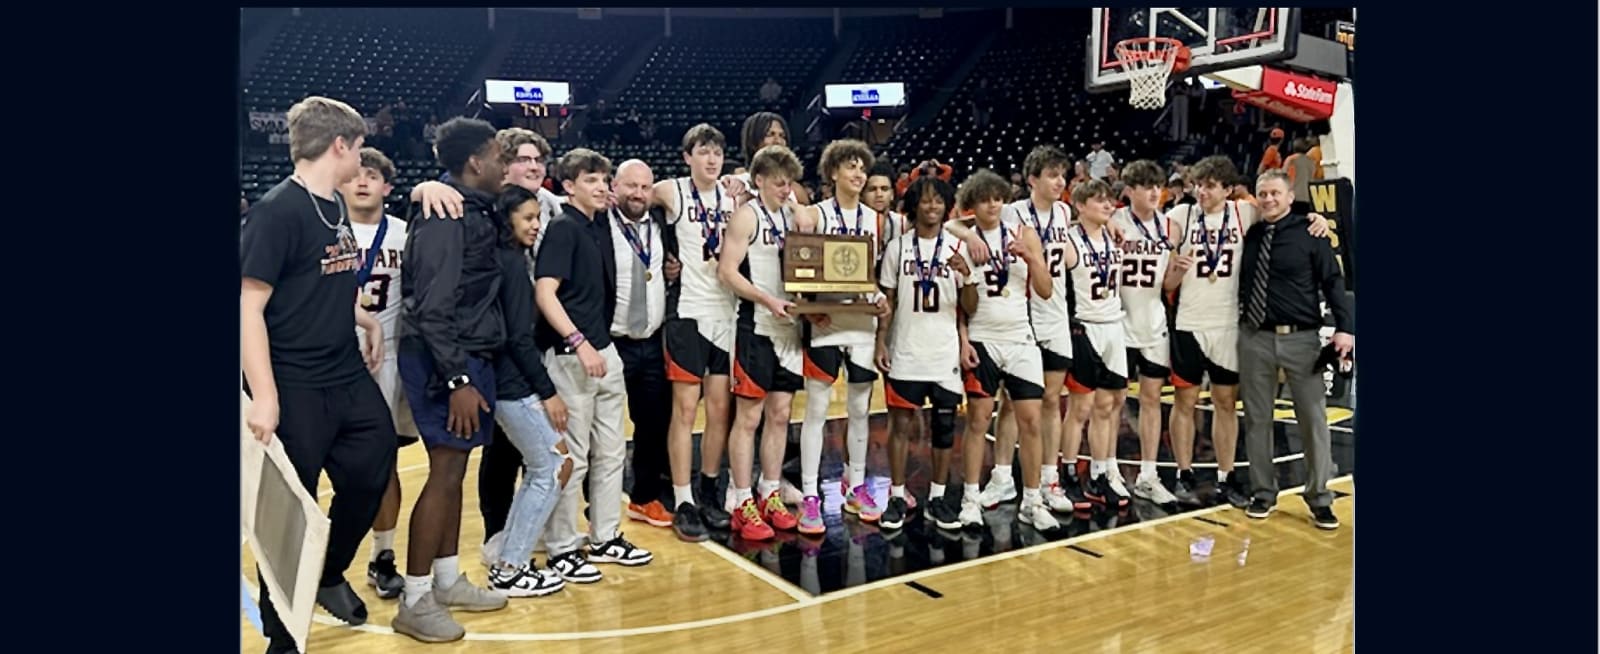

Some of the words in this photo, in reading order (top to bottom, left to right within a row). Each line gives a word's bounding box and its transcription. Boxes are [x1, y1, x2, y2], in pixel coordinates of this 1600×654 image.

[1122, 258, 1158, 288] 25
[1196, 248, 1234, 278] 23
[912, 280, 940, 313] 10
[1090, 268, 1118, 301] 24
